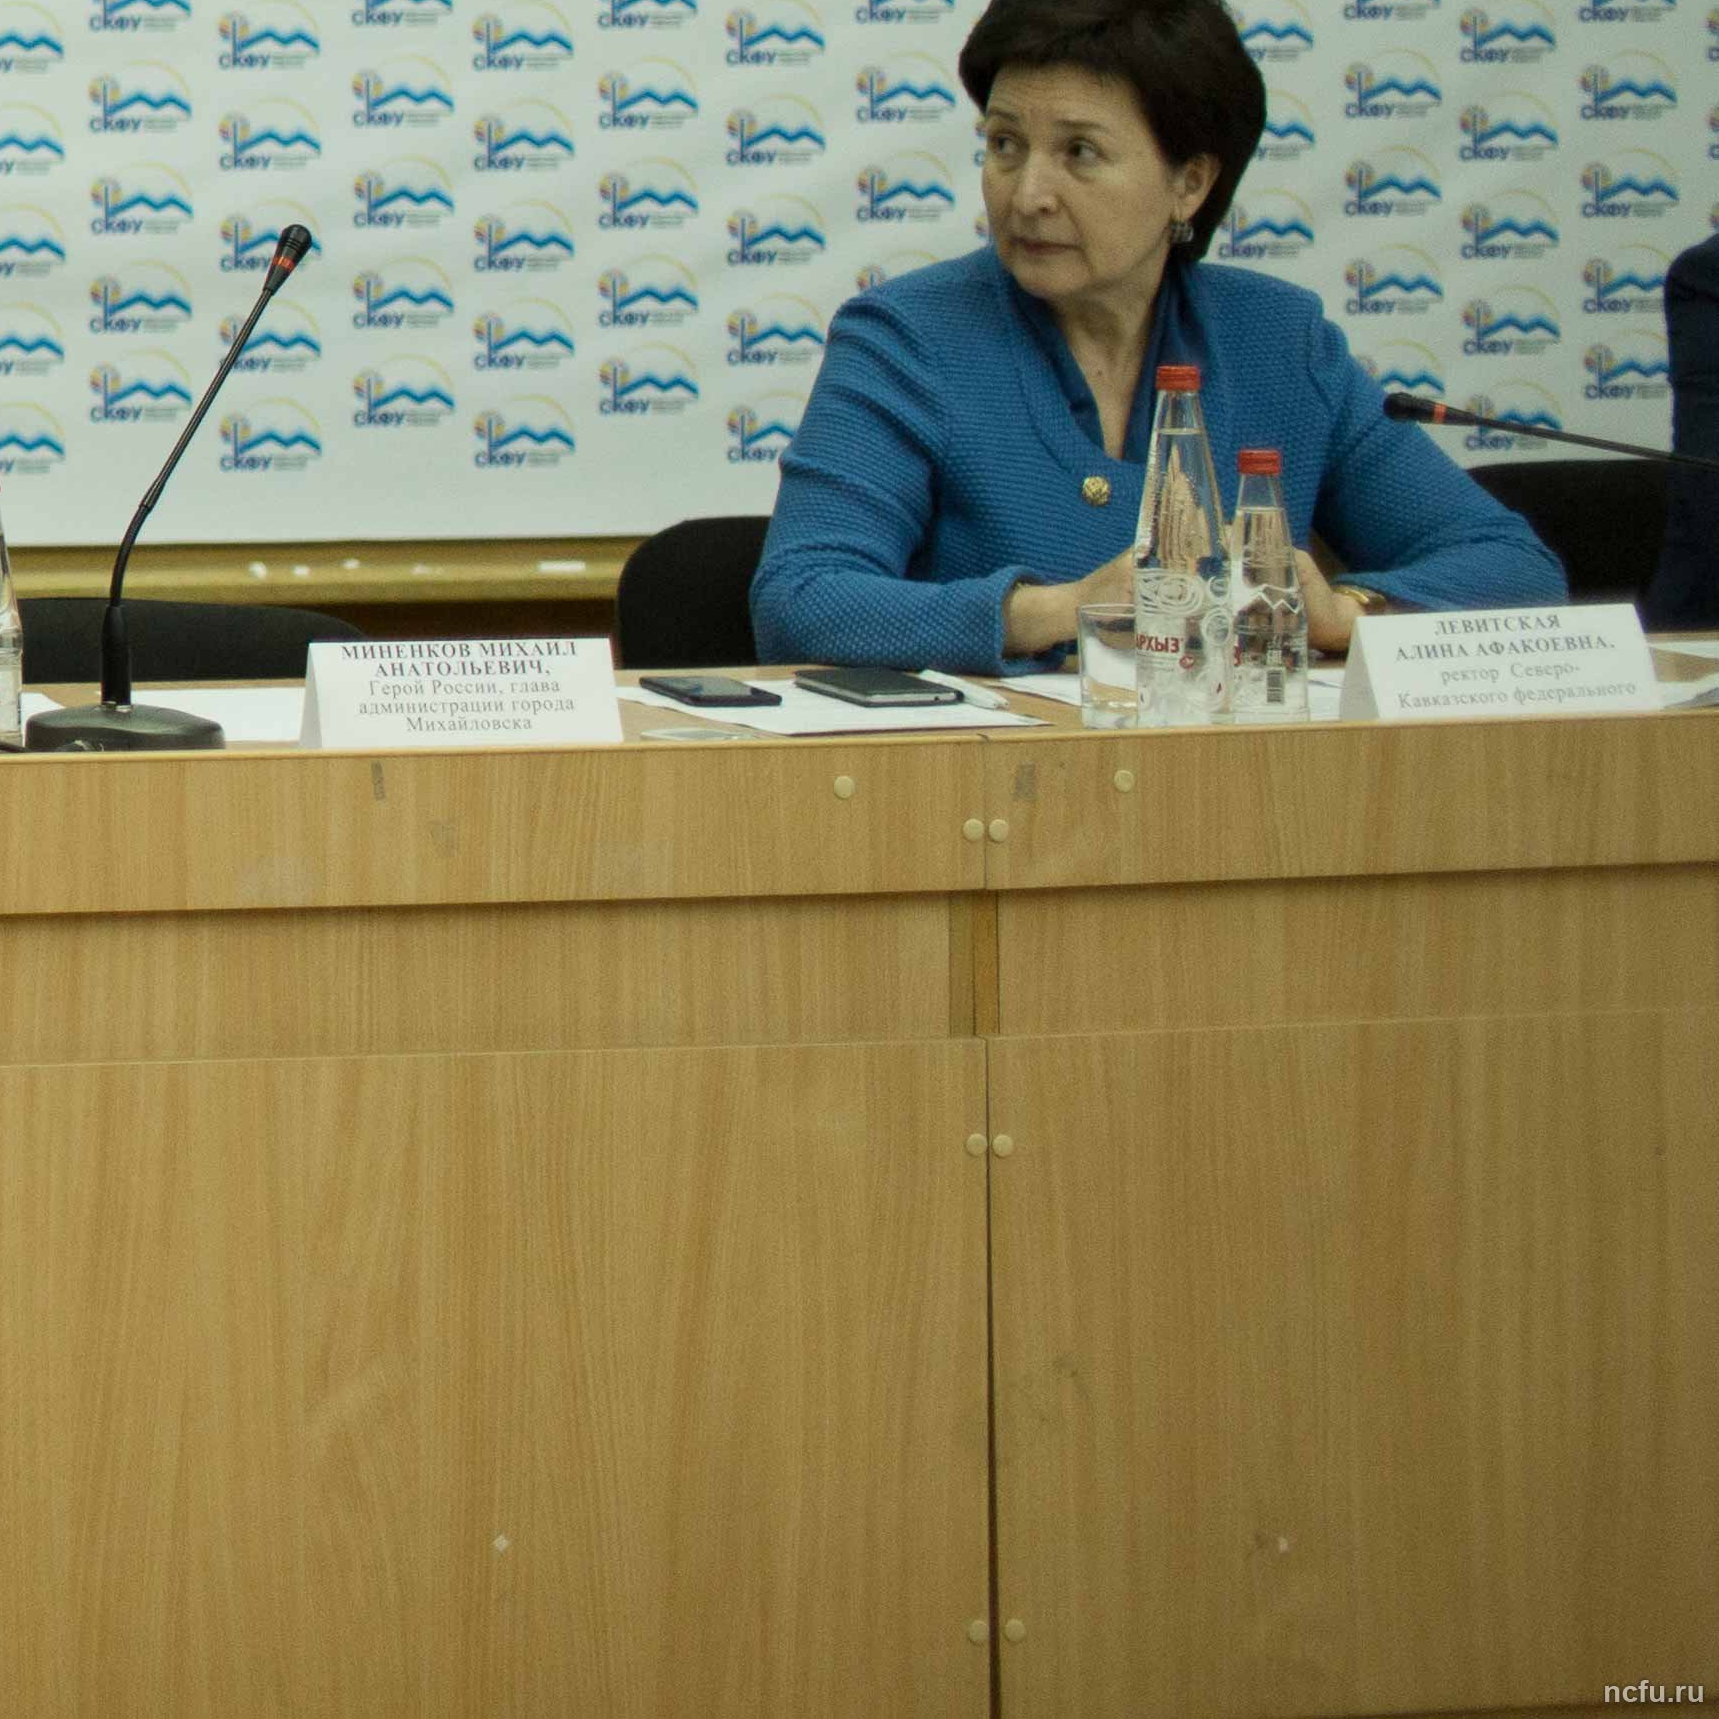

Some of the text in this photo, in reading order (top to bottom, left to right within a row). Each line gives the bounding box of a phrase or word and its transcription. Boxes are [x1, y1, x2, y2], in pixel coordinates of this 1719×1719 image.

[1433, 614, 1561, 635] ЛЕВИТСКАЯ
[340, 640, 577, 660] МИНЕНКОВ МИХАИЛ
[1395, 642, 1470, 661] АЛИНА
[1440, 668, 1500, 685] ректор
[369, 679, 425, 699] Герой
[510, 680, 561, 693] глава
[1398, 682, 1637, 709] Кавказского федерального
[357, 698, 575, 717] администрации города
[405, 715, 533, 732] Михайловска
